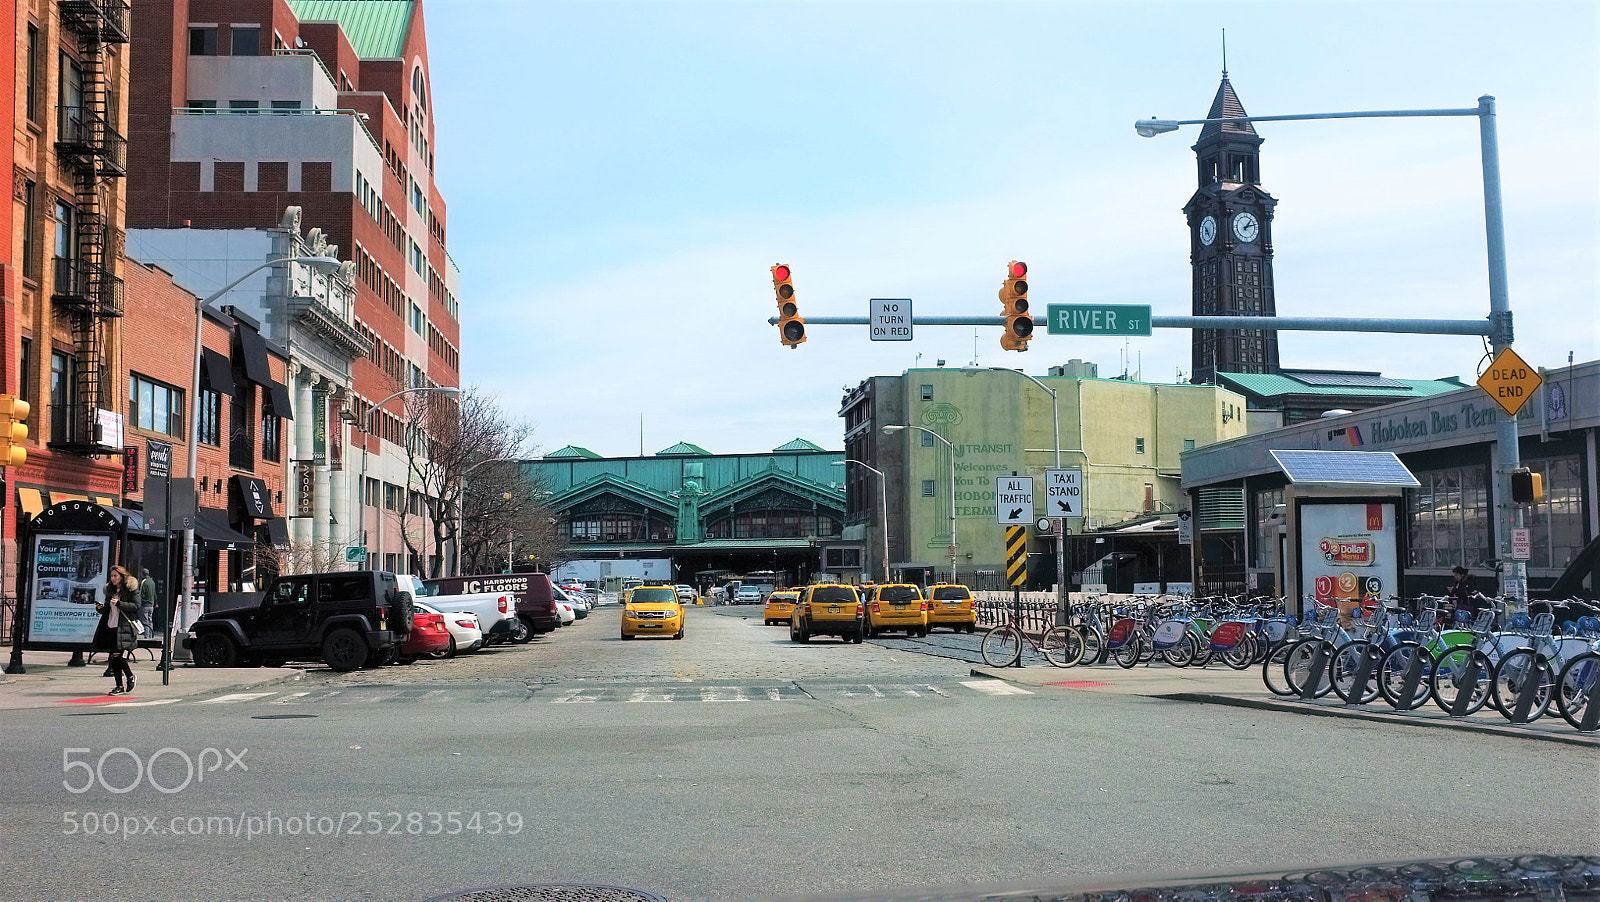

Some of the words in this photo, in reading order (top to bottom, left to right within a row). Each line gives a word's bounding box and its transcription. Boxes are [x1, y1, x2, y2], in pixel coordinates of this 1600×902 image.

[883, 304, 899, 312] NO
[879, 315, 904, 324] TURN
[1058, 309, 1117, 330] RIVER
[1128, 319, 1141, 330] ST
[873, 327, 886, 336] ON
[891, 327, 909, 336] RED
[1492, 368, 1527, 381] DEAD
[1498, 386, 1523, 398] END
[1370, 415, 1428, 444] Hoboken
[1430, 410, 1458, 435] Bus
[1461, 397, 1535, 429] Termal
[966, 444, 1013, 454] TRANSIT
[126, 448, 136, 490] PIZZA
[953, 463, 1008, 472] Welcomes
[954, 476, 974, 486] You
[976, 476, 990, 486] To
[1054, 474, 1075, 484] TAXI
[302, 464, 310, 514] AVOCADO
[1007, 481, 1023, 491] ALL
[1048, 486, 1080, 497] STAND
[999, 494, 1032, 504] TRAFFIC
[36, 503, 116, 527] HOBOKEN
[39, 545, 58, 553] Your
[1340, 545, 1366, 554] Dollar
[37, 565, 77, 573] Commute
[483, 577, 528, 585] HARDWOOD
[1341, 576, 1352, 588] $2
[1369, 580, 1379, 592] $3
[461, 580, 481, 594] JC
[483, 583, 528, 592] FLOORS
